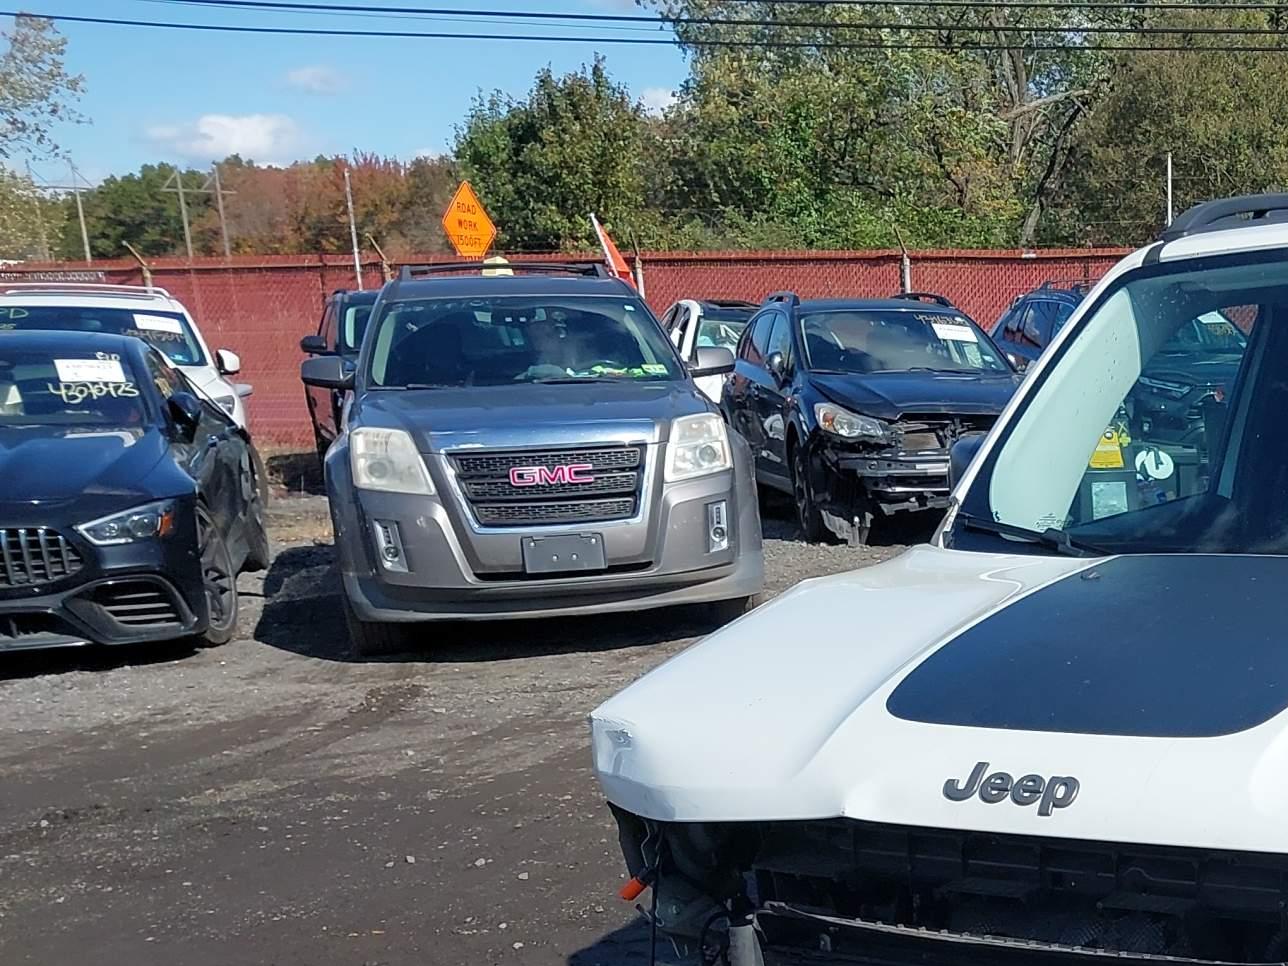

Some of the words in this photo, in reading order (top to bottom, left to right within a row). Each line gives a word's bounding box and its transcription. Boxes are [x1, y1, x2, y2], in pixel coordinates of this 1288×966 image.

[457, 202, 477, 215] ROAD
[457, 218, 479, 232] WORK
[509, 464, 594, 486] GMC
[942, 761, 1081, 817] Jeep
